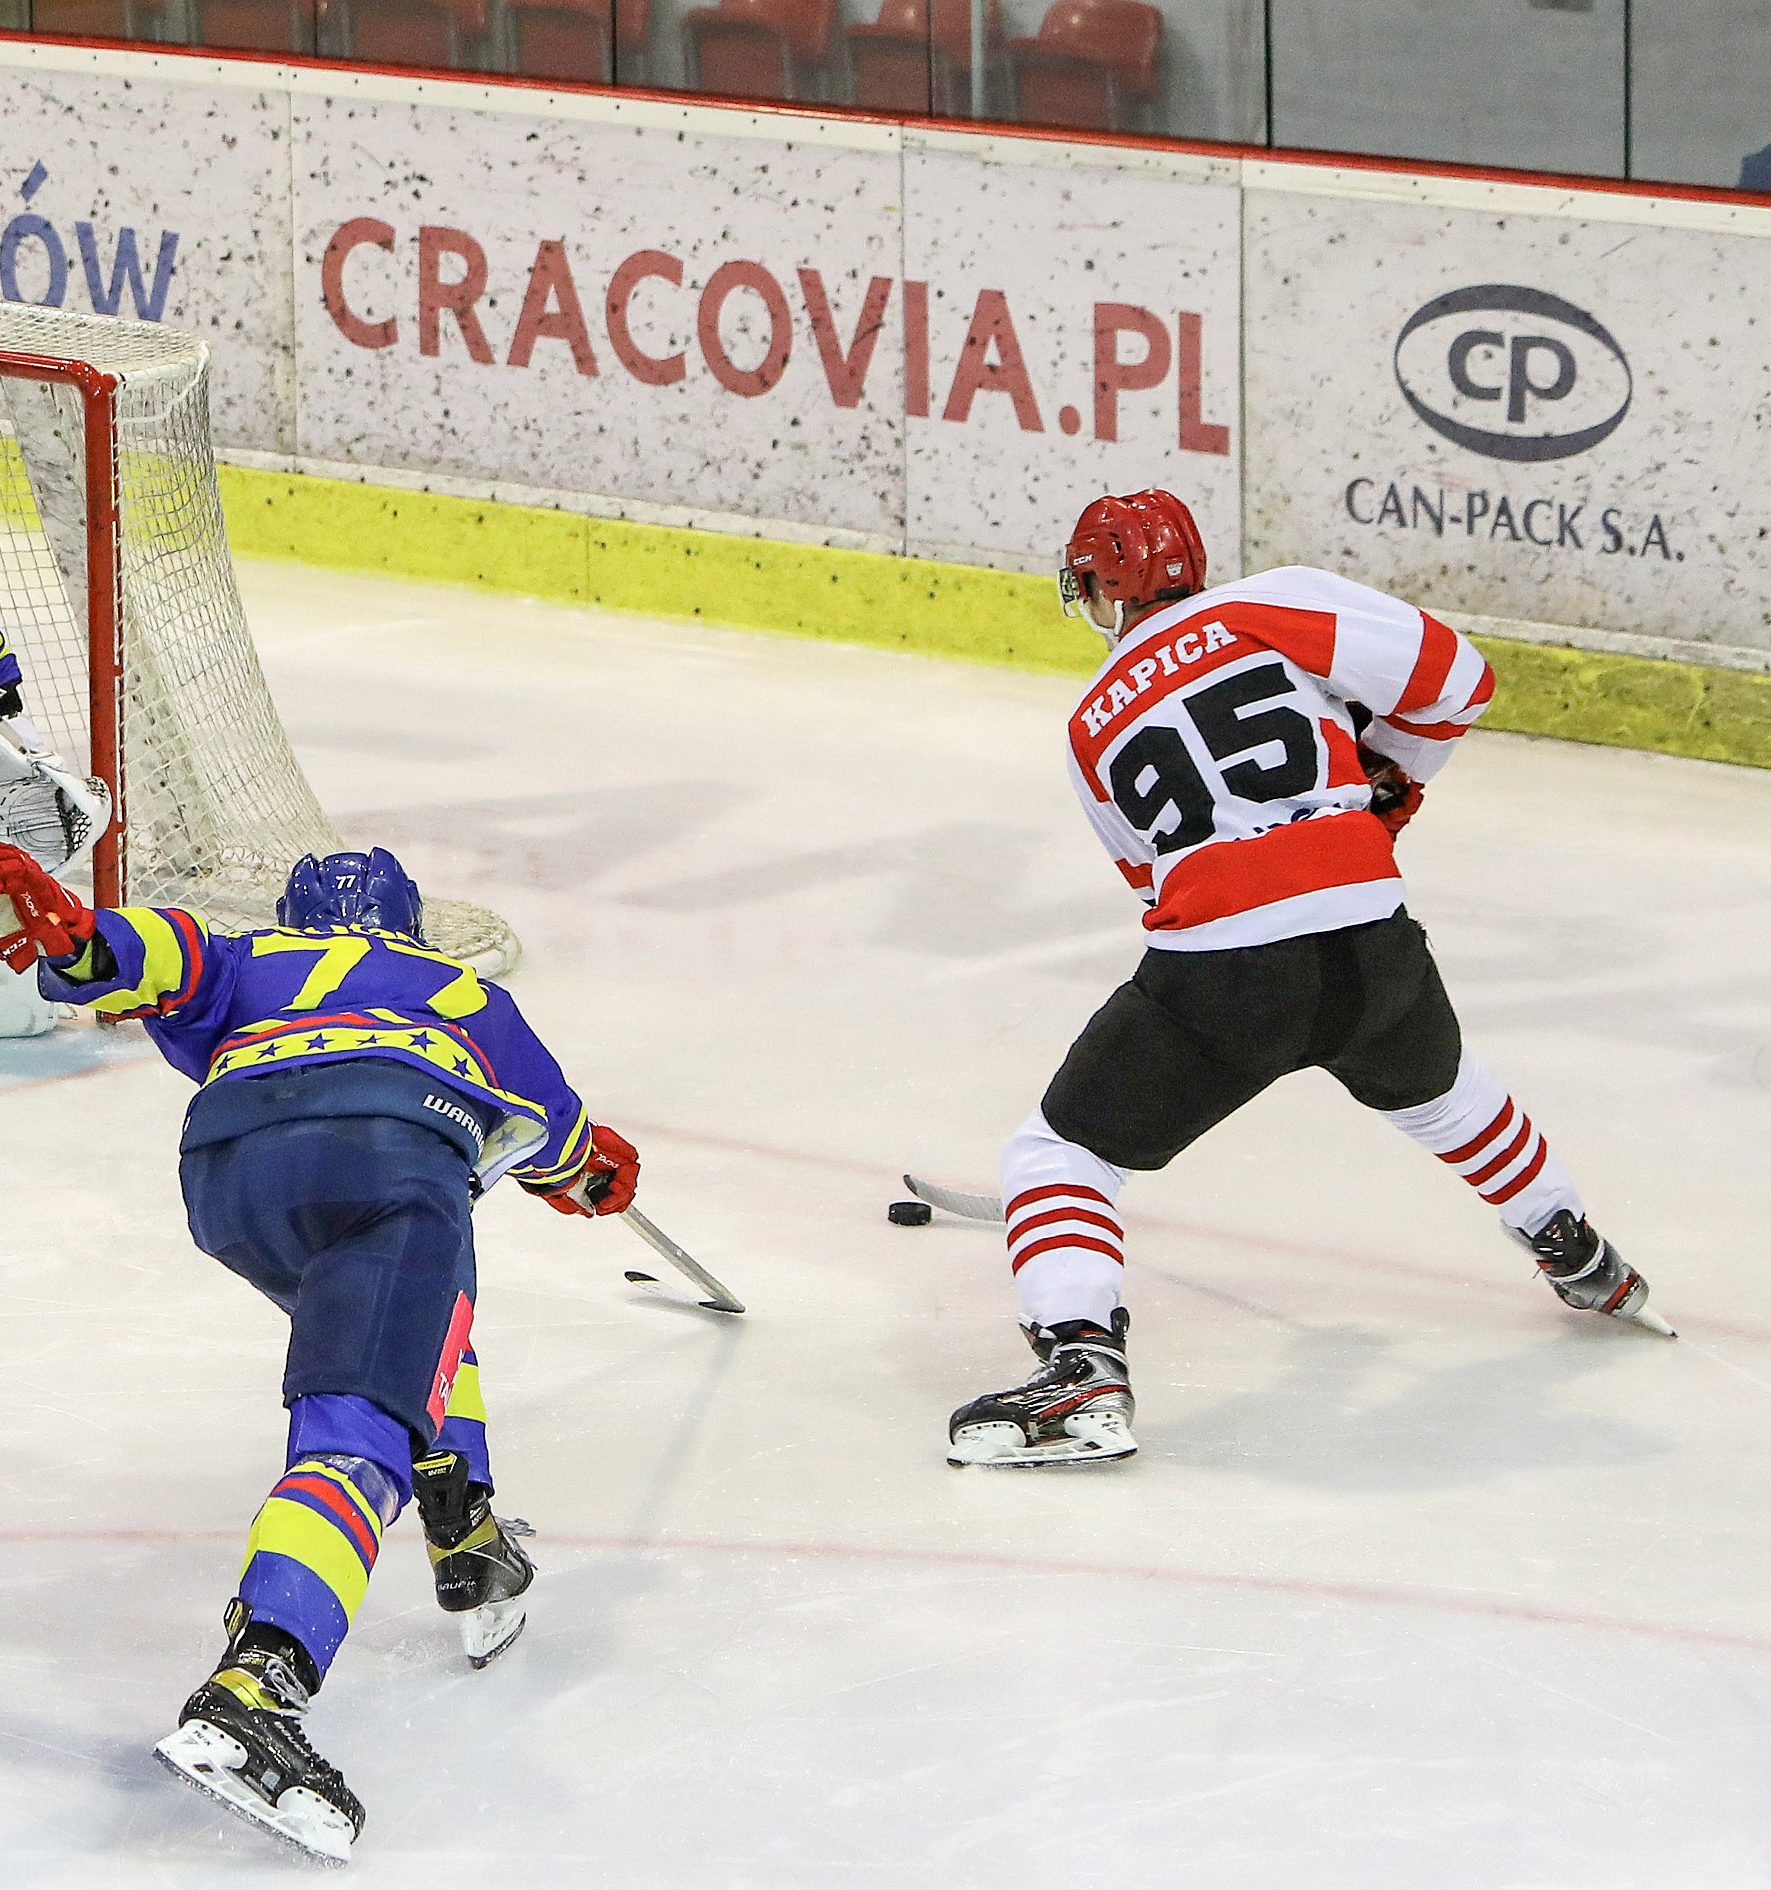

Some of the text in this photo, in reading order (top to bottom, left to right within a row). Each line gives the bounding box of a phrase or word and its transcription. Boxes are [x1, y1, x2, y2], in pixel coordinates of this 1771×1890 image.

[321, 217, 1232, 457] CRACOVIA.PL
[1073, 554, 1093, 566] CCM
[1344, 477, 1685, 563] CAN-PACK S.A.
[1080, 620, 1238, 738] KAPICA
[1109, 662, 1319, 857] 95
[335, 874, 358, 890] 77
[251, 933, 488, 1020] 77
